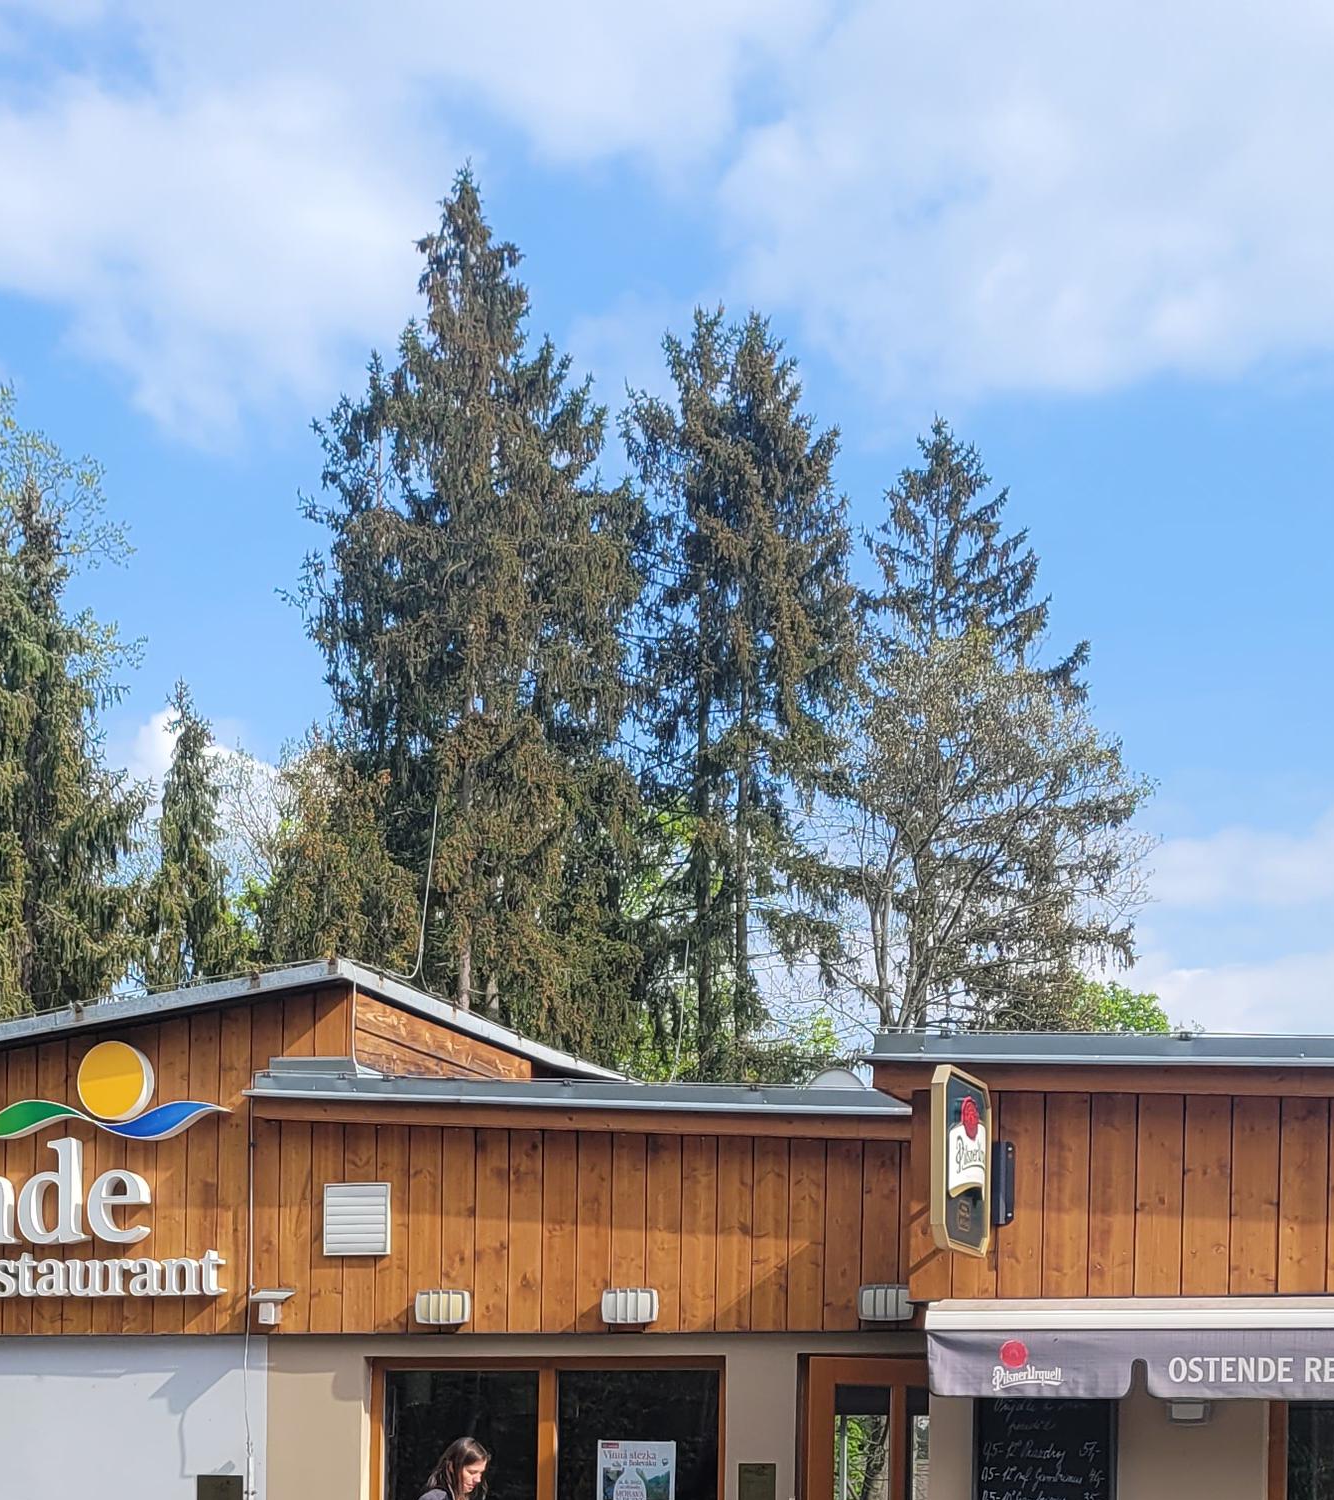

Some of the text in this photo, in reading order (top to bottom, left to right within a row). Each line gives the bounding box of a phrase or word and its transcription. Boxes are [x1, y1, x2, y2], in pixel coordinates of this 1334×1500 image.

[992, 1365, 1062, 1391] Pilsner Urquell
[1168, 1356, 1294, 1384] OSTENDE
